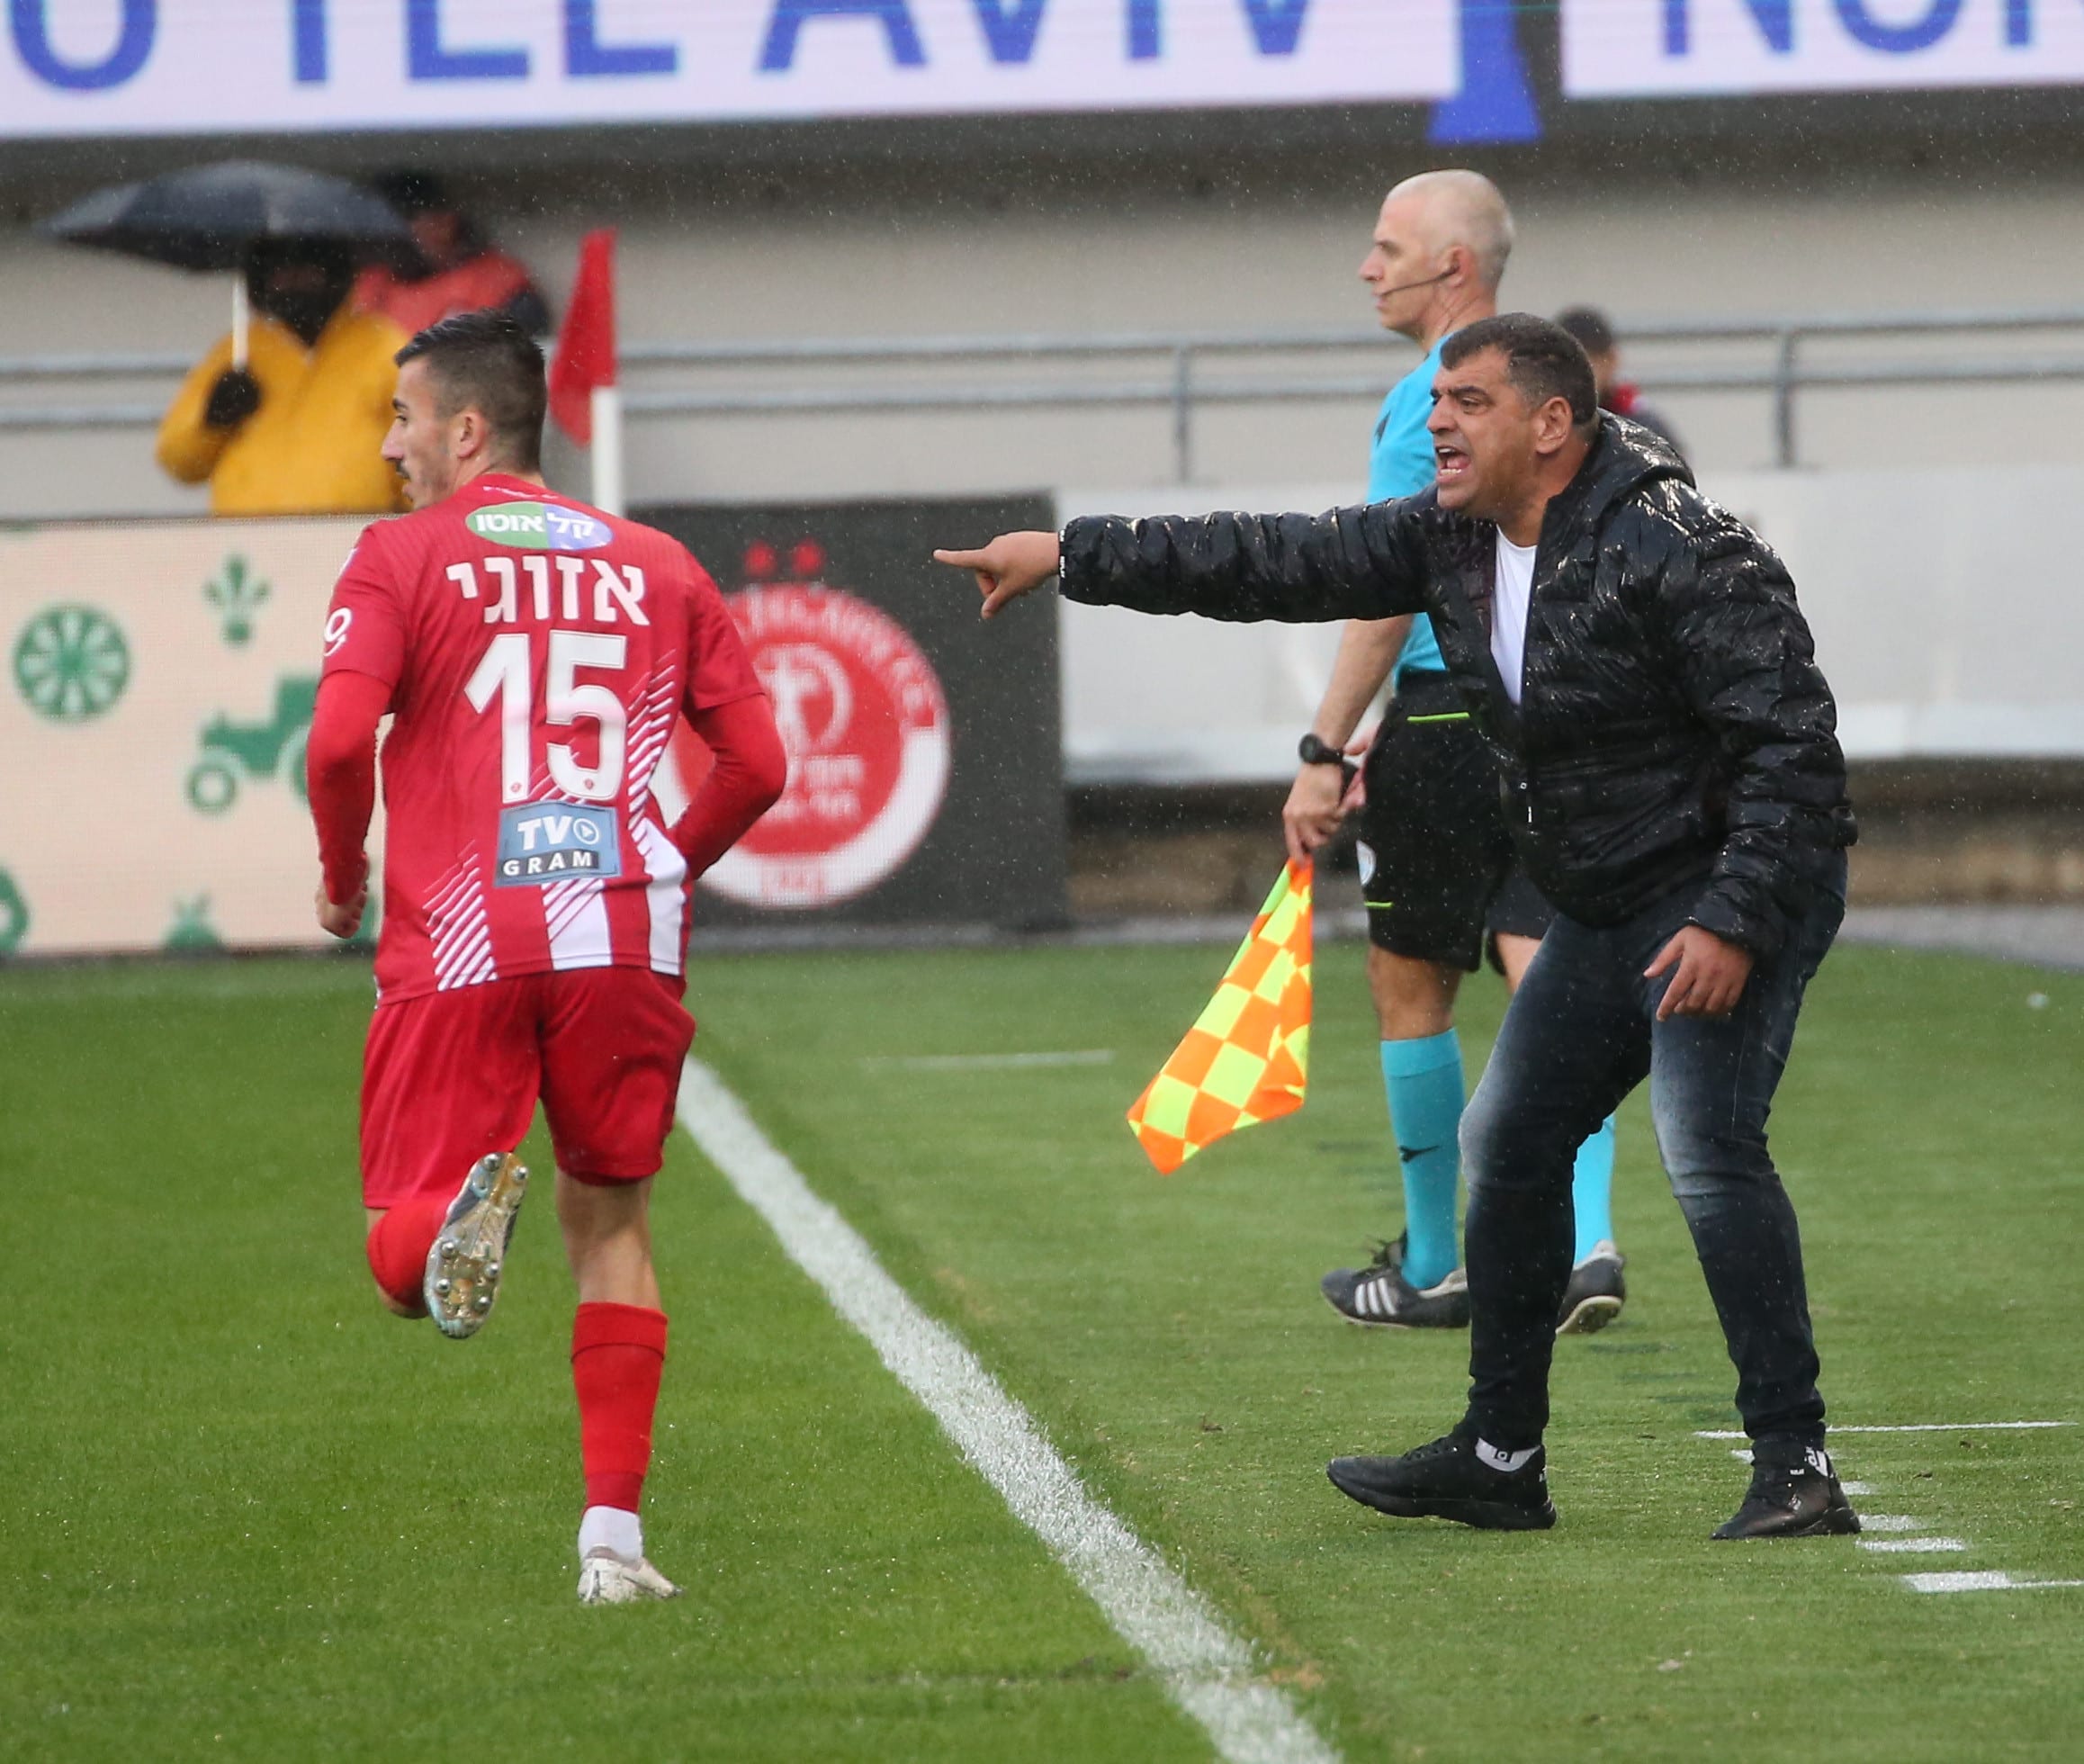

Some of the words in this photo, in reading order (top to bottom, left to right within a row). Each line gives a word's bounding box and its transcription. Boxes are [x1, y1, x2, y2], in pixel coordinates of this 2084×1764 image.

[475, 514, 546, 533] אוטו
[546, 512, 594, 539] קל
[445, 555, 651, 626] אזוגי
[463, 629, 627, 804] 15
[503, 850, 592, 876] GRAM
